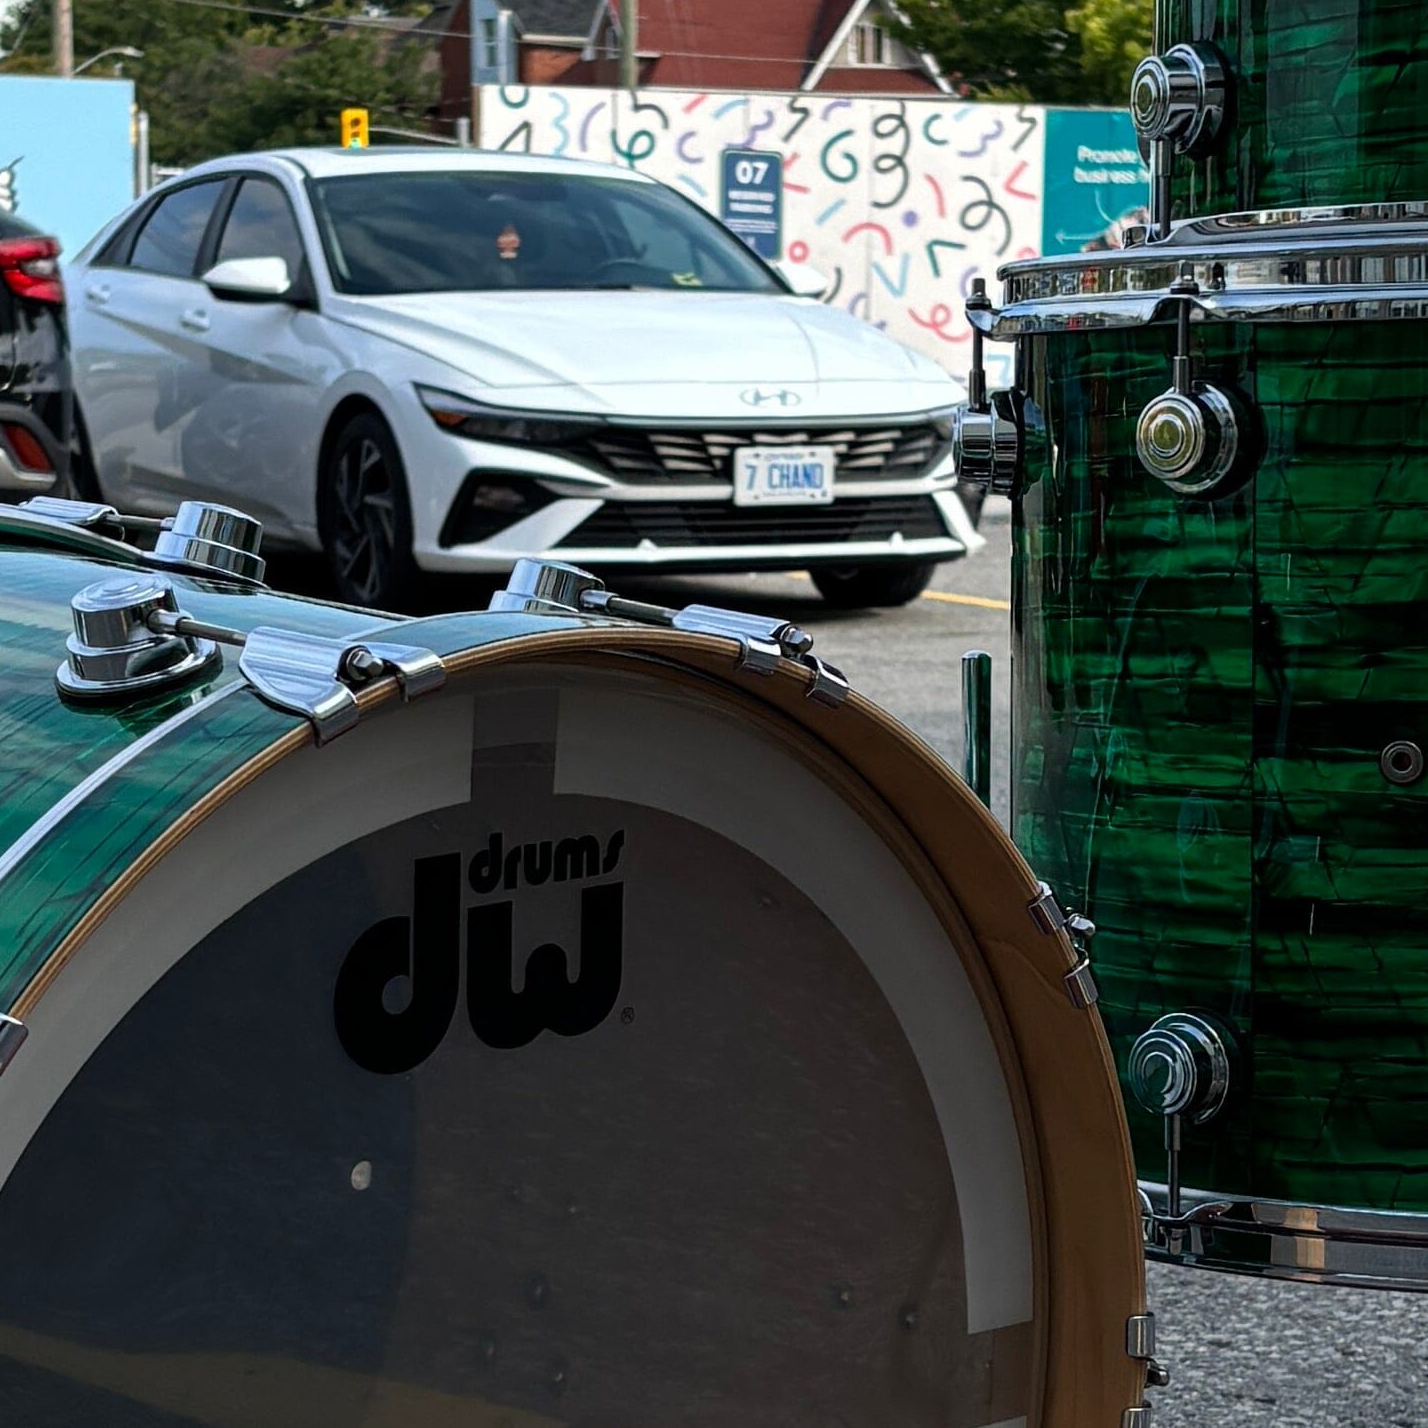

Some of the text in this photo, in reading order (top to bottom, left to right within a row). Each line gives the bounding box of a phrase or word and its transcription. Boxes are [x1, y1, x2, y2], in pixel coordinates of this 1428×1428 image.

[735, 161, 769, 184] 07
[745, 464, 756, 490] 7
[468, 829, 625, 894] drums
[333, 852, 624, 1075] dw
